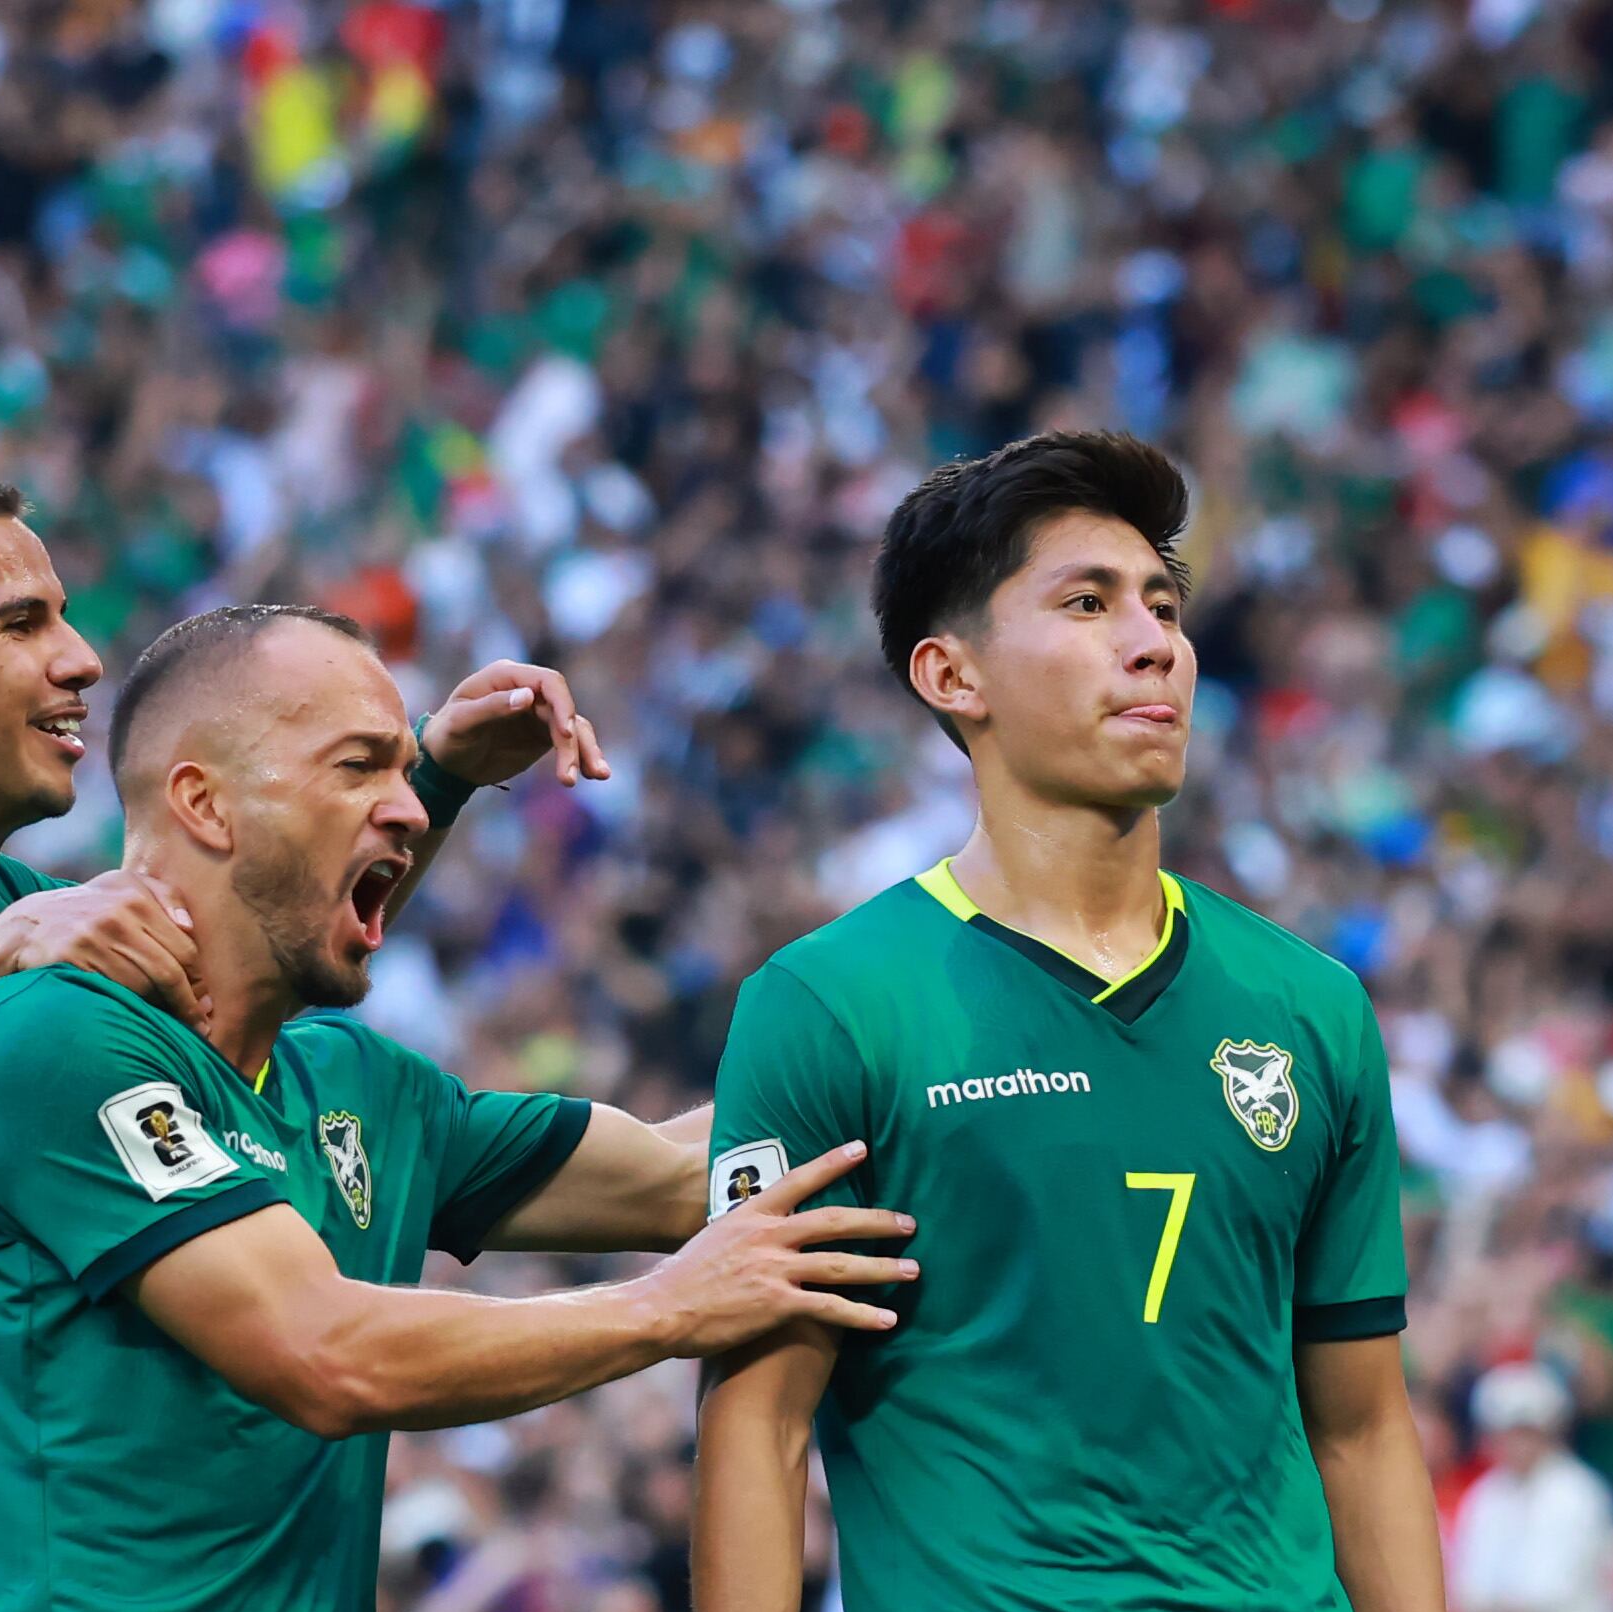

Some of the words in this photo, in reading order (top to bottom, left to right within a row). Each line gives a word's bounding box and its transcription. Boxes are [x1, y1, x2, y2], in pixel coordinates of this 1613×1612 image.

[926, 1068, 1091, 1109] marathon
[1255, 1111, 1277, 1135] FBF
[1125, 1172, 1196, 1324] 7
